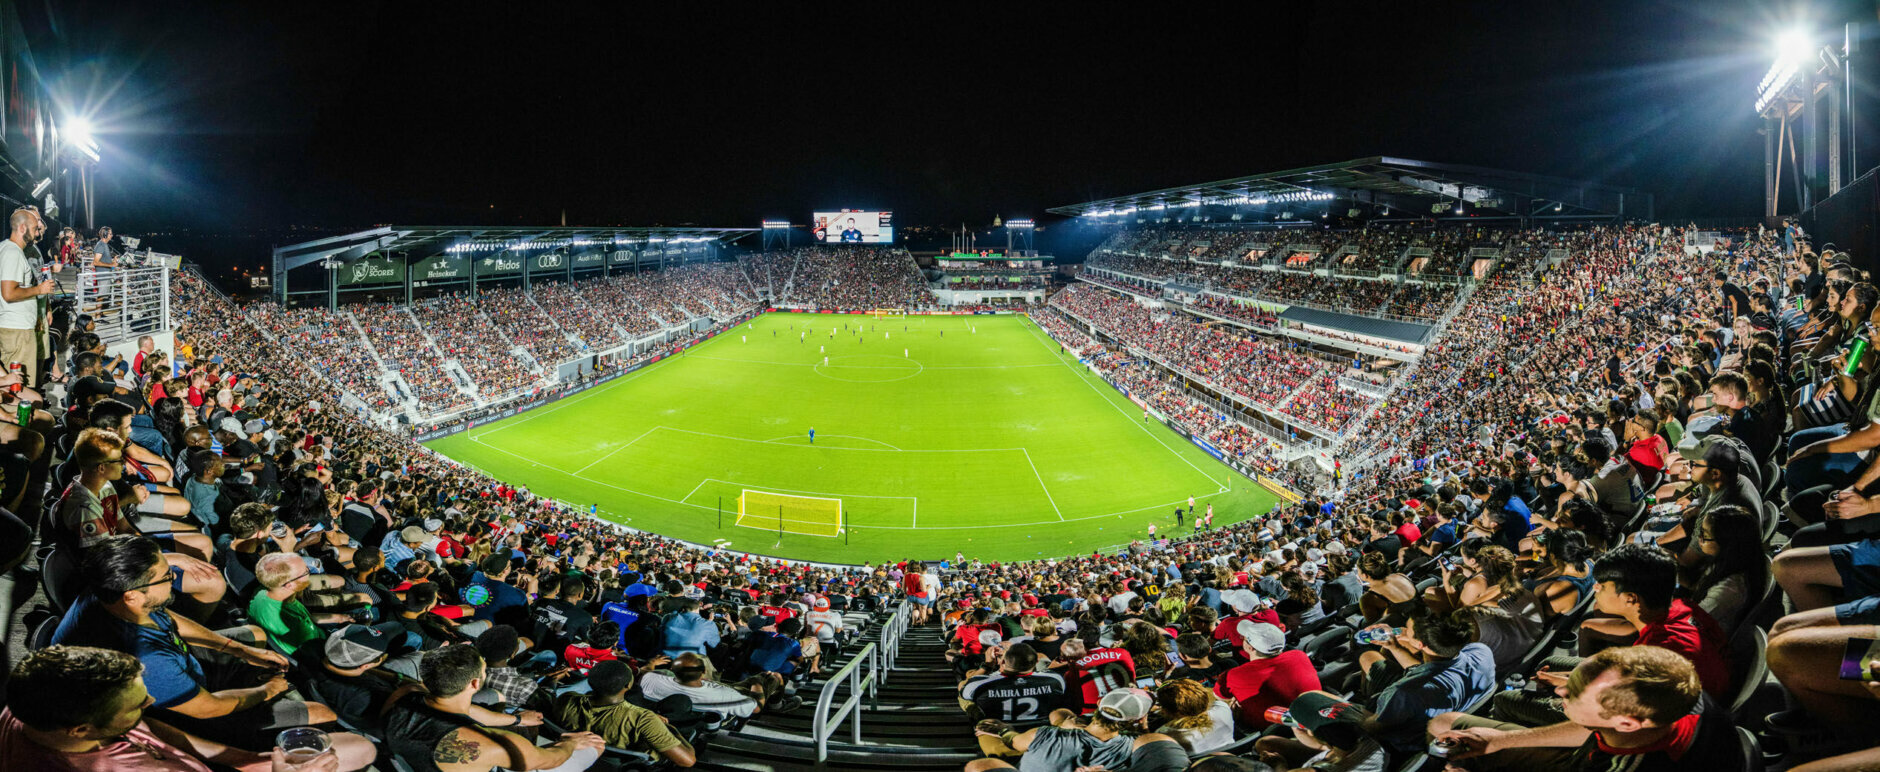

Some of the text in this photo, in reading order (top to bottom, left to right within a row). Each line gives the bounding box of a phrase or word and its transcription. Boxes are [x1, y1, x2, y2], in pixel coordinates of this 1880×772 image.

[495, 259, 520, 271] leidos
[577, 255, 590, 263] Audi
[369, 268, 394, 277] SCORES
[427, 268, 458, 278] Heineken
[523, 399, 546, 411] Audi Sport
[474, 413, 501, 425] Audi Sport
[416, 428, 449, 441] Audi Sport
[1143, 583, 1159, 597] 10
[608, 606, 632, 617] CHELSEA
[814, 620, 825, 634] 7
[1076, 651, 1122, 667] ROONEY
[1087, 661, 1131, 698] 10
[988, 685, 1053, 698] BARRA BRAVA
[1001, 697, 1040, 721] 12
